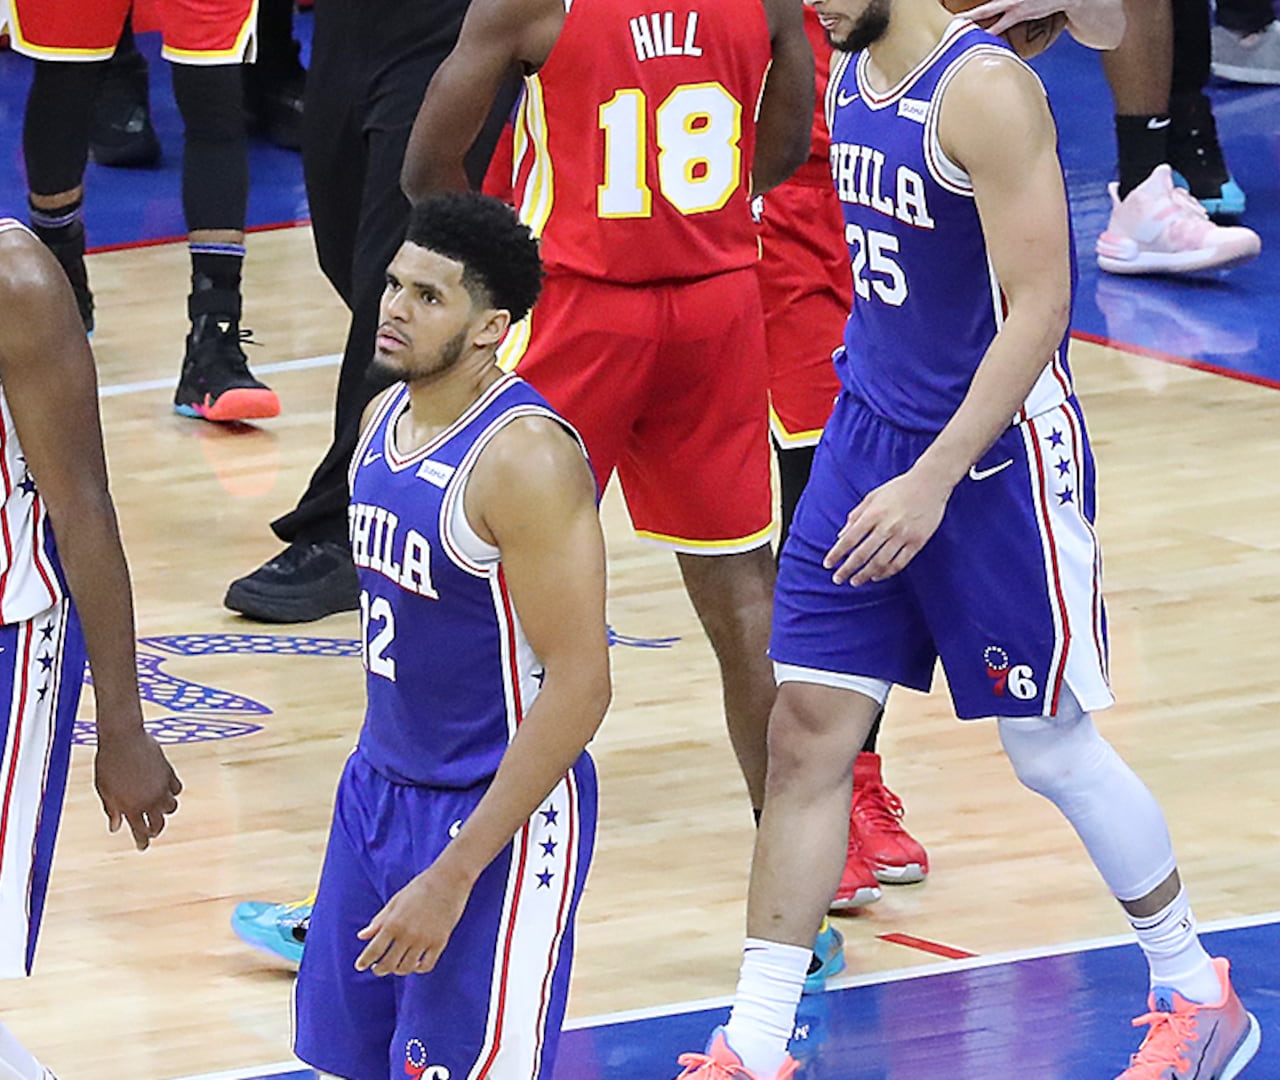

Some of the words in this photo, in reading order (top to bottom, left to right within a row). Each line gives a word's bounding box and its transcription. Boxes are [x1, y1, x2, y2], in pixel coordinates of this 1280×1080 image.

[629, 10, 704, 62] HILL
[597, 81, 743, 218] 18
[845, 222, 909, 307] 25
[986, 665, 1039, 700] 76
